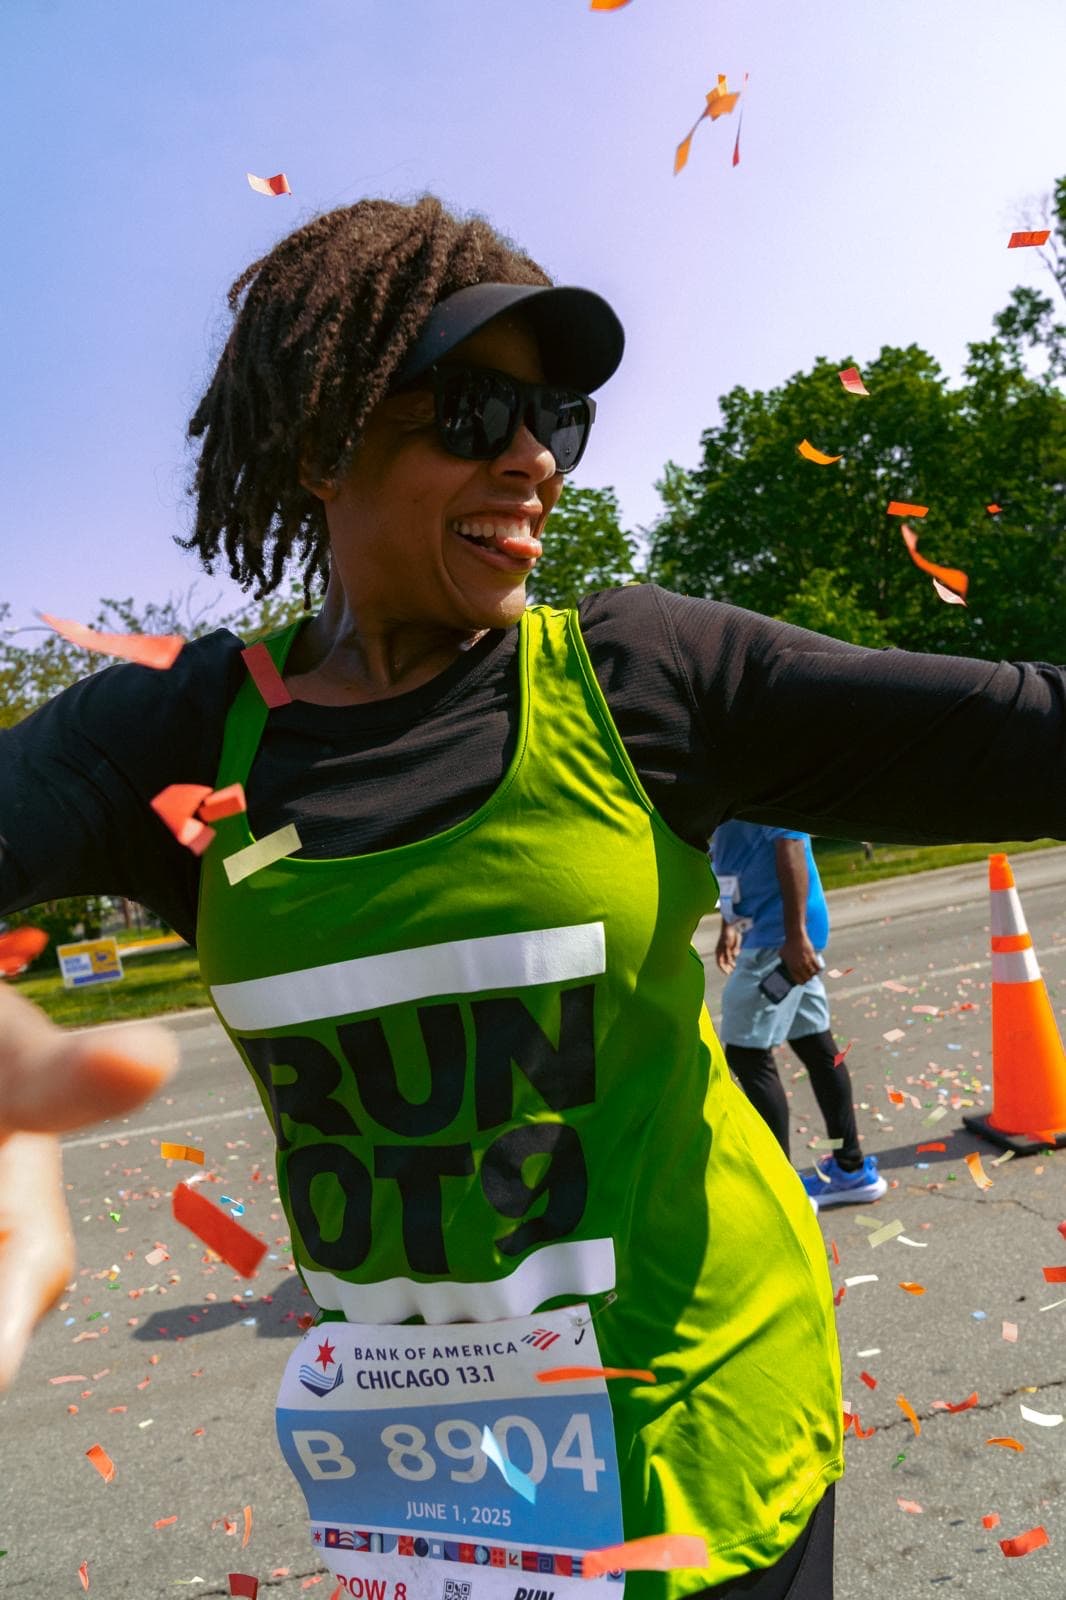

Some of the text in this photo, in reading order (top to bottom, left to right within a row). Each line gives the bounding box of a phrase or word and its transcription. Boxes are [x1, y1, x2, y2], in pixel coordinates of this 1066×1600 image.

[237, 983, 596, 1151] RUN
[285, 1122, 589, 1275] OT9
[354, 1340, 519, 1361] BANK OF AMERICA
[356, 1364, 496, 1390] CHICAGO 13.1
[291, 1412, 606, 1493] B 8904
[406, 1500, 512, 1527] JUNE 1, 2025
